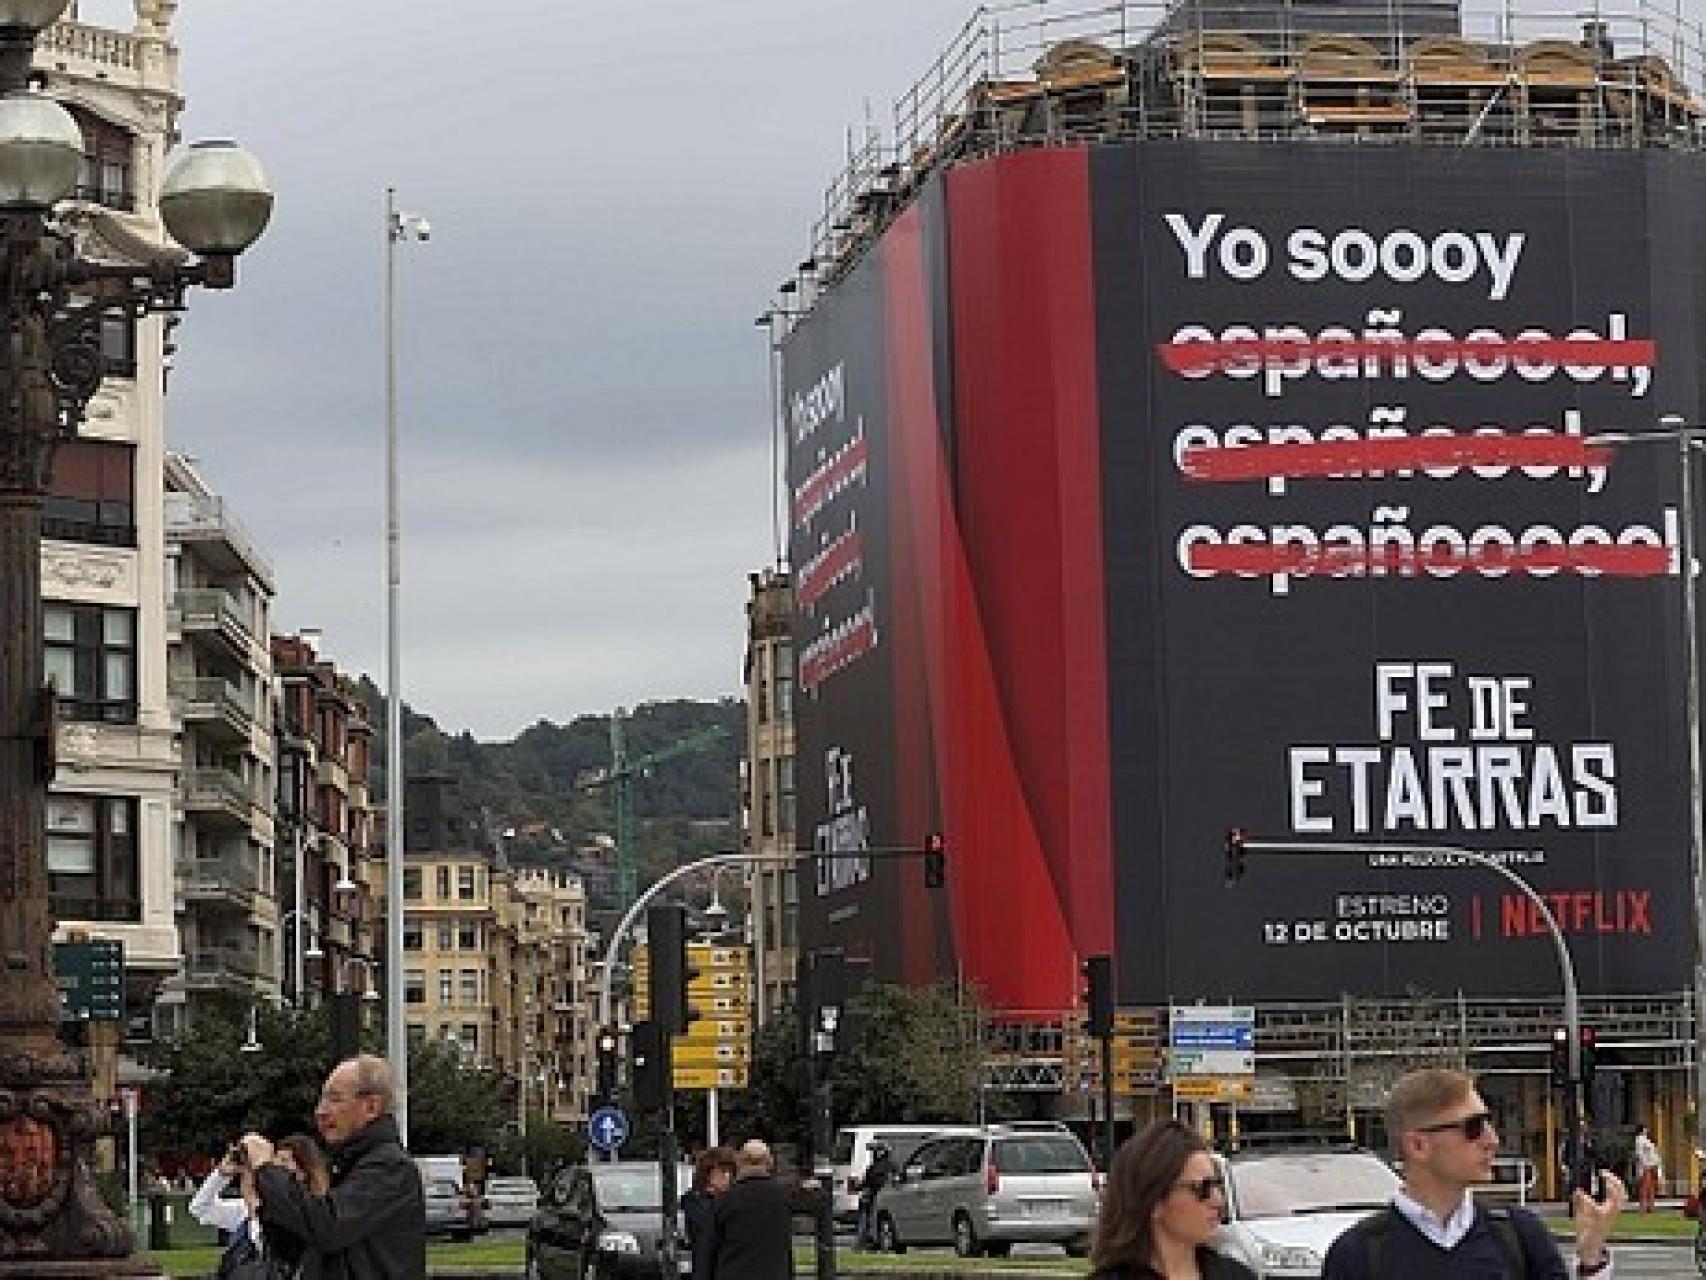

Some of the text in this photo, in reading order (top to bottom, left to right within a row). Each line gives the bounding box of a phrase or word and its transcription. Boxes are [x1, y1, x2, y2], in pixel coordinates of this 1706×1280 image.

[1164, 213, 1526, 300] Yo soooy
[1376, 662, 1533, 741] FE DE
[1290, 743, 1618, 833] ETARRAS
[1263, 920, 1449, 944] 12 DE OCTUBRE
[1337, 893, 1449, 918] ESTRENO
[1501, 890, 1652, 937] NETFLIX
